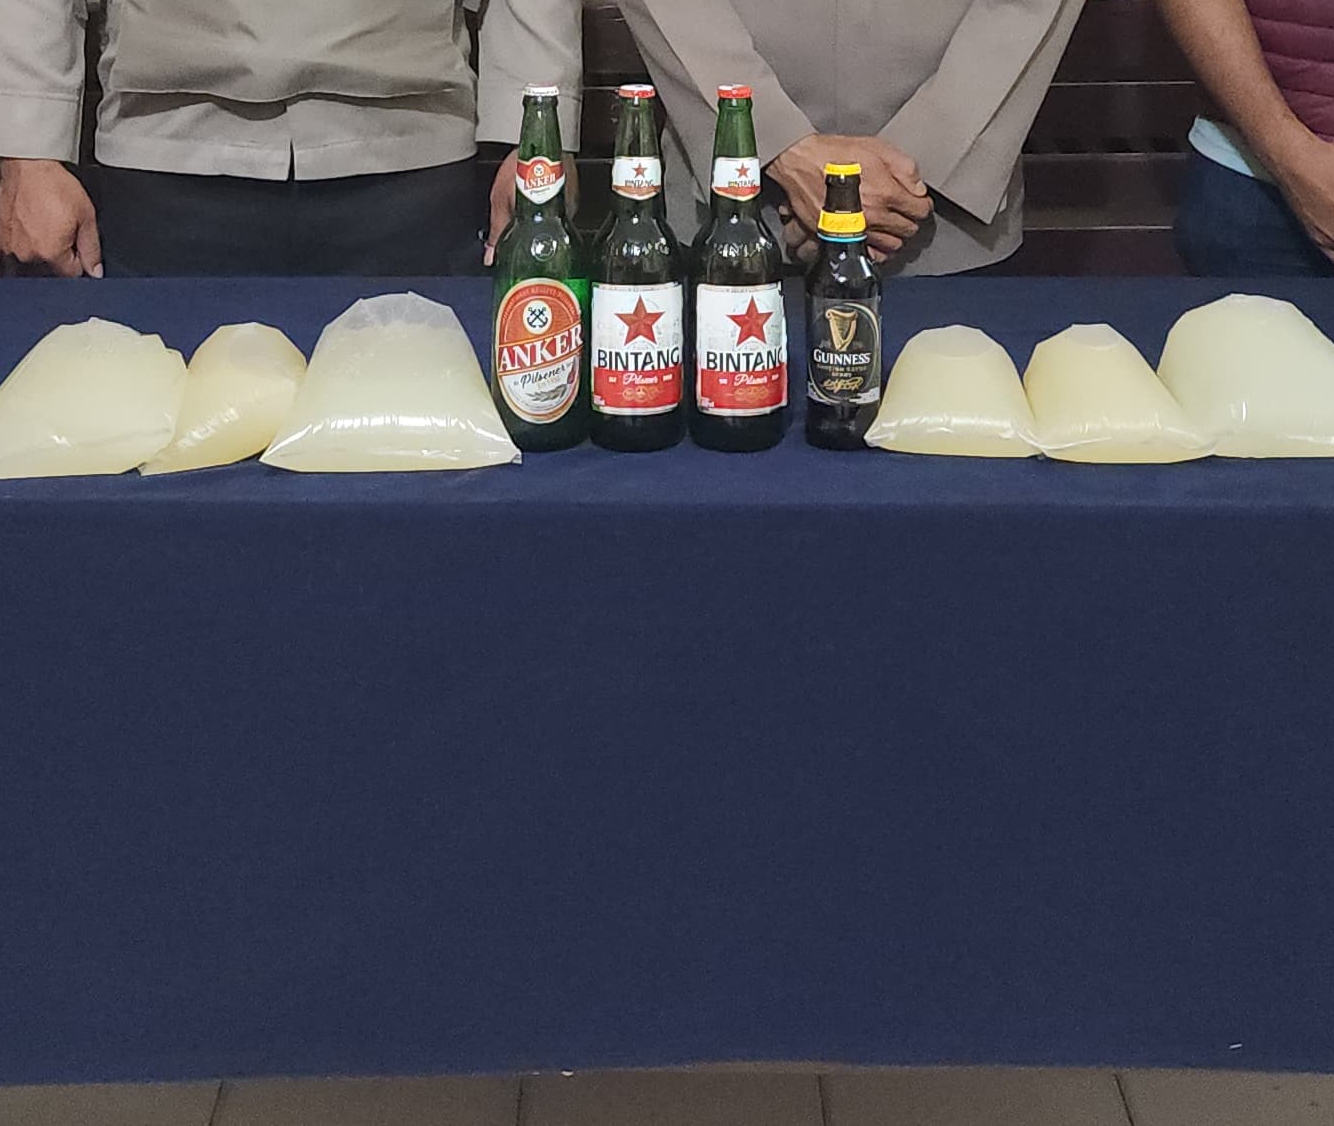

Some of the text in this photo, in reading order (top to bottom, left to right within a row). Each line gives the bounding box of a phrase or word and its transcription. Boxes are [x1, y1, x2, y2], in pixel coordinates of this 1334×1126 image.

[498, 323, 584, 373] ANKER
[597, 346, 680, 371] BINTANG
[706, 347, 783, 372] BINTANG
[813, 348, 873, 366] GUINNESS
[520, 365, 566, 389] Pilsener
